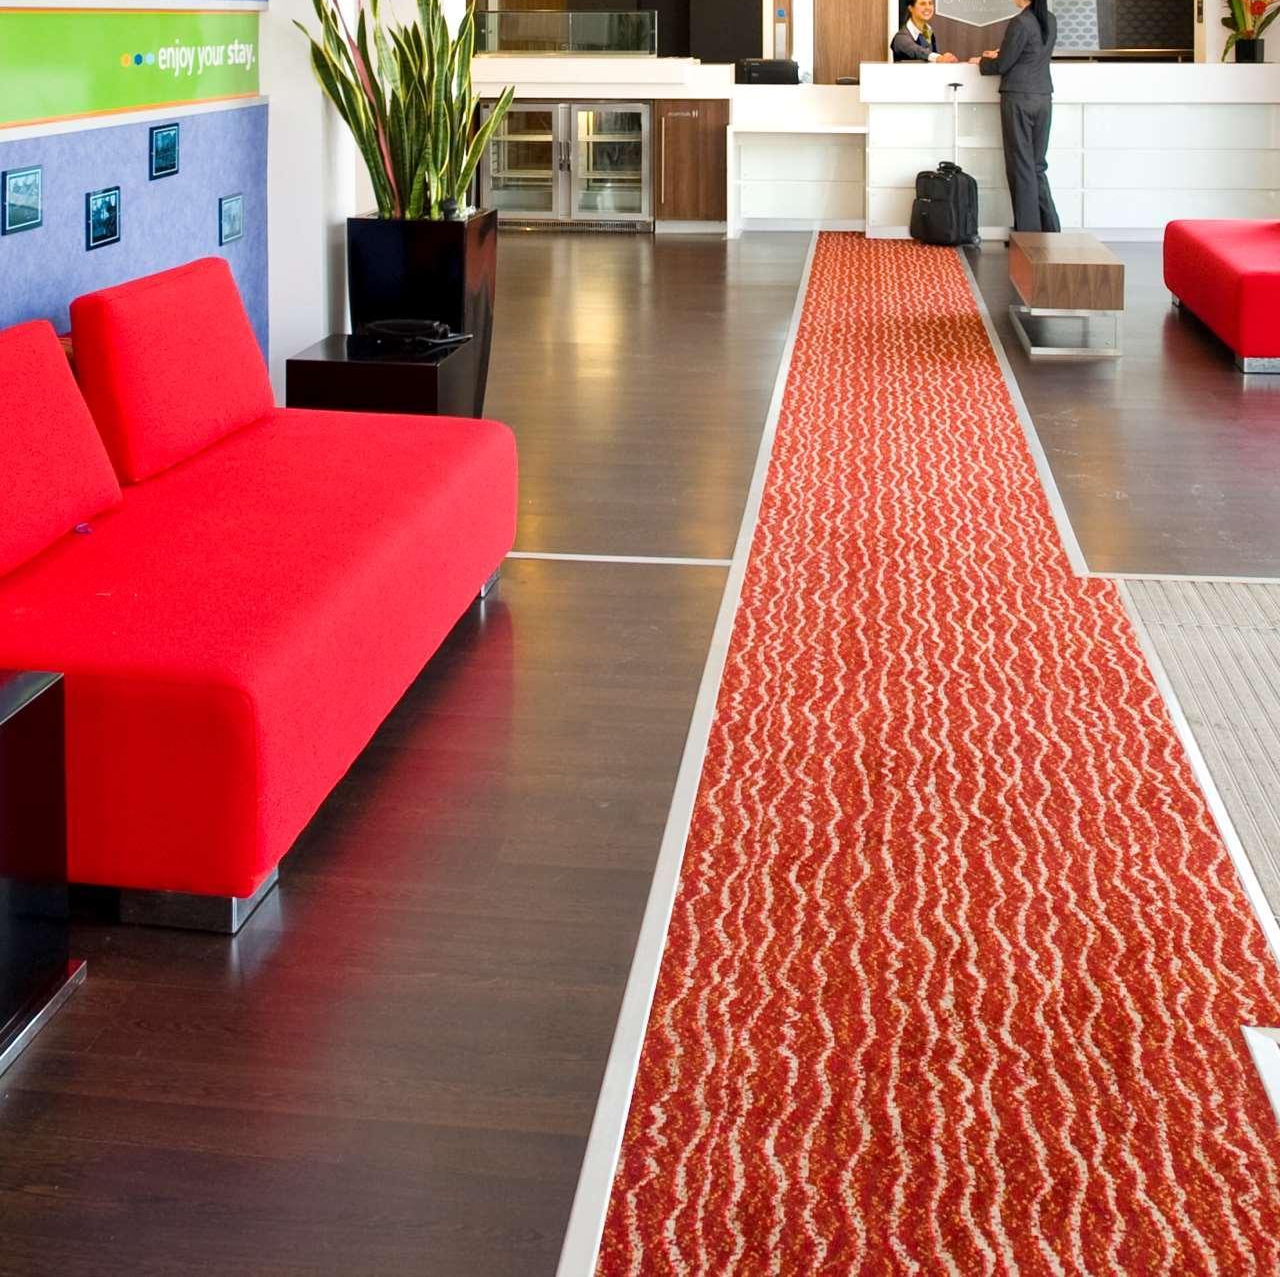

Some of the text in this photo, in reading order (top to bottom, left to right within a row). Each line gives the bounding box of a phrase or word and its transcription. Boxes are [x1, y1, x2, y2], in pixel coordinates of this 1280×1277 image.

[158, 39, 256, 77] enjoy your stay.
